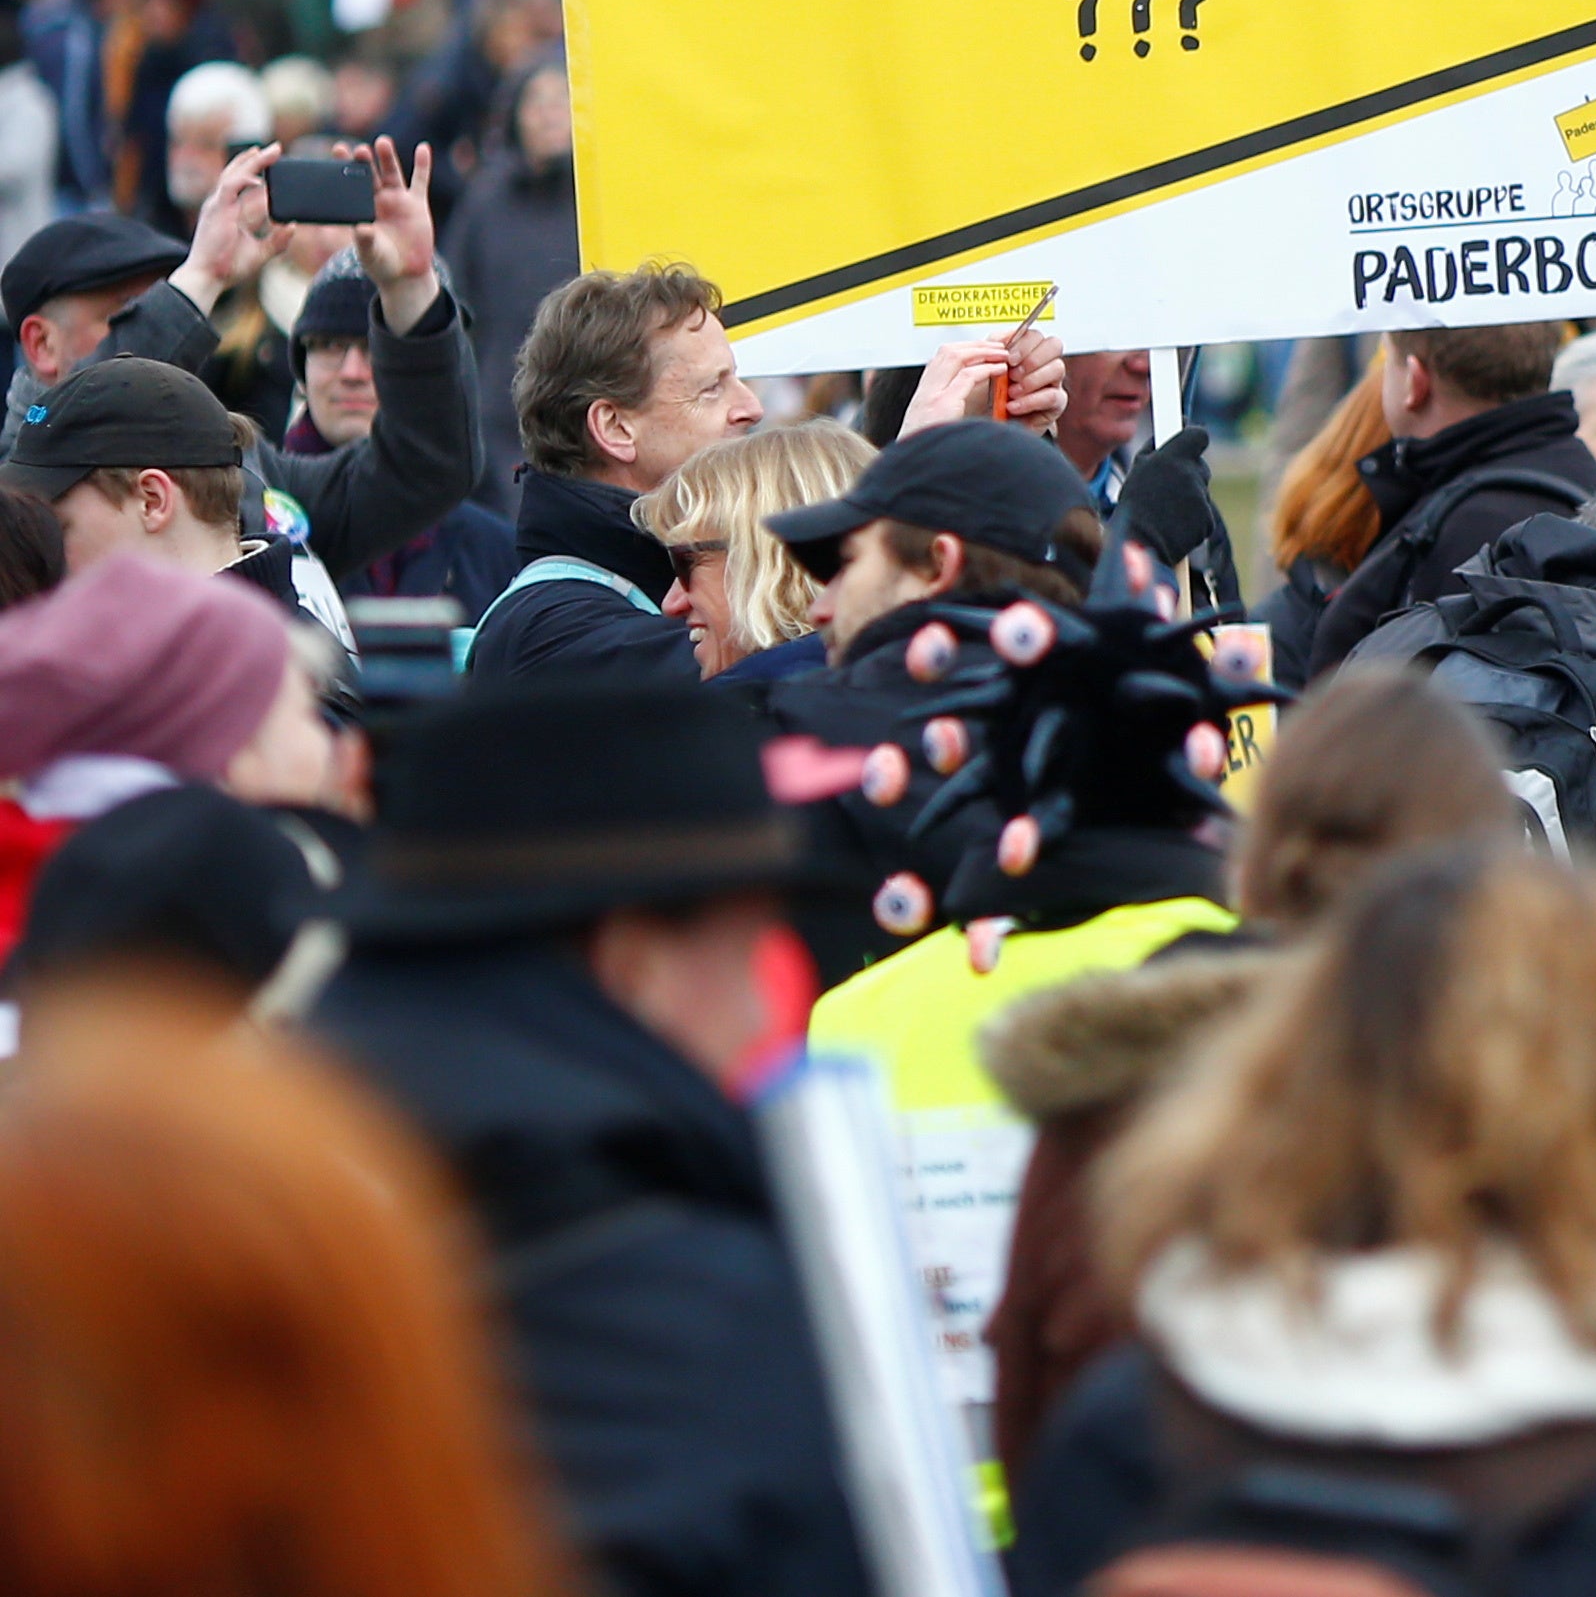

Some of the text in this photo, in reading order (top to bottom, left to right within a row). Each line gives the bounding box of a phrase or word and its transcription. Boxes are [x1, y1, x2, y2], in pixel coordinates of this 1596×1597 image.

[1349, 184, 1526, 224] ORTSGRUPPE
[918, 286, 1048, 304] DEMOKRATISCHER
[937, 303, 1031, 319] WIDERSTAND
